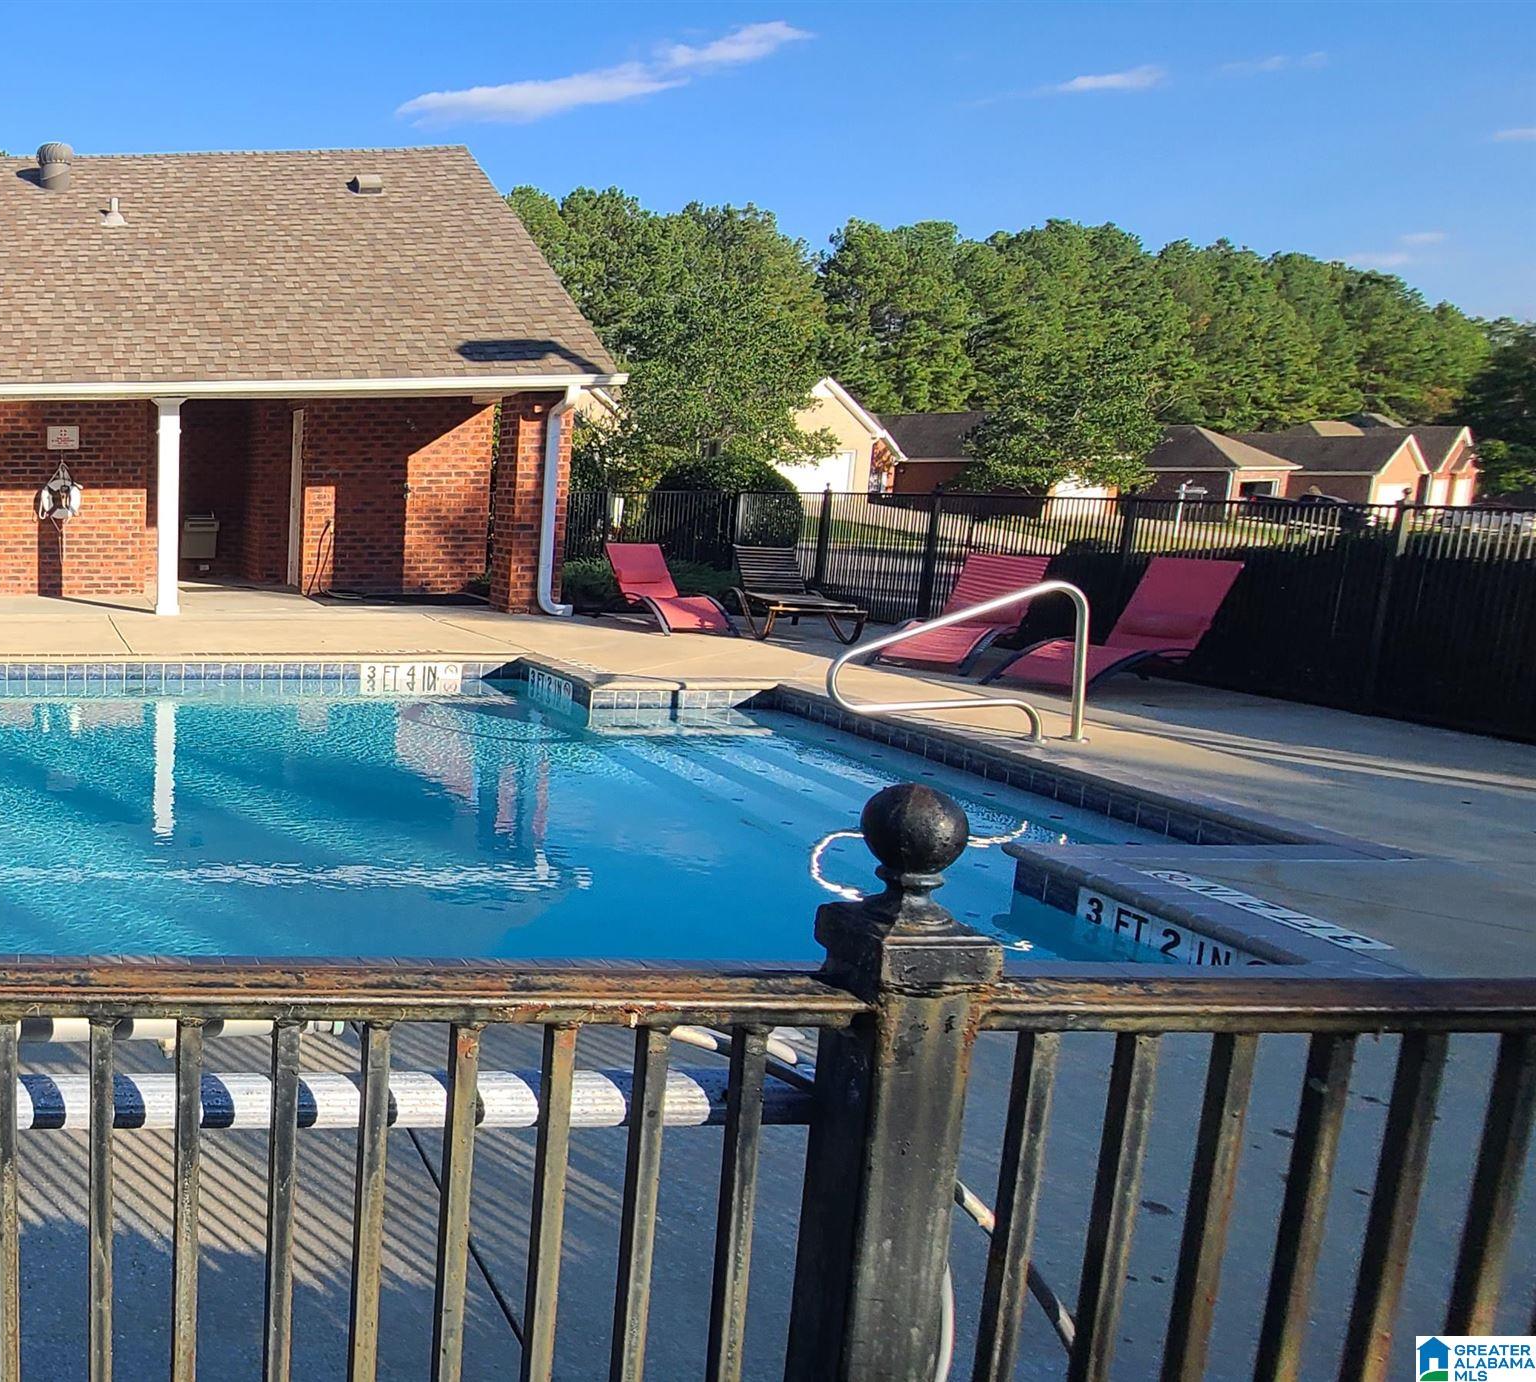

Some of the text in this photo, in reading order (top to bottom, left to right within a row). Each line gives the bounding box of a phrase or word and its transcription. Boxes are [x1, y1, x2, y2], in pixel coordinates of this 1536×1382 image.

[367, 665, 376, 679] 3
[1086, 897, 1231, 965] 3 FT 2 IN
